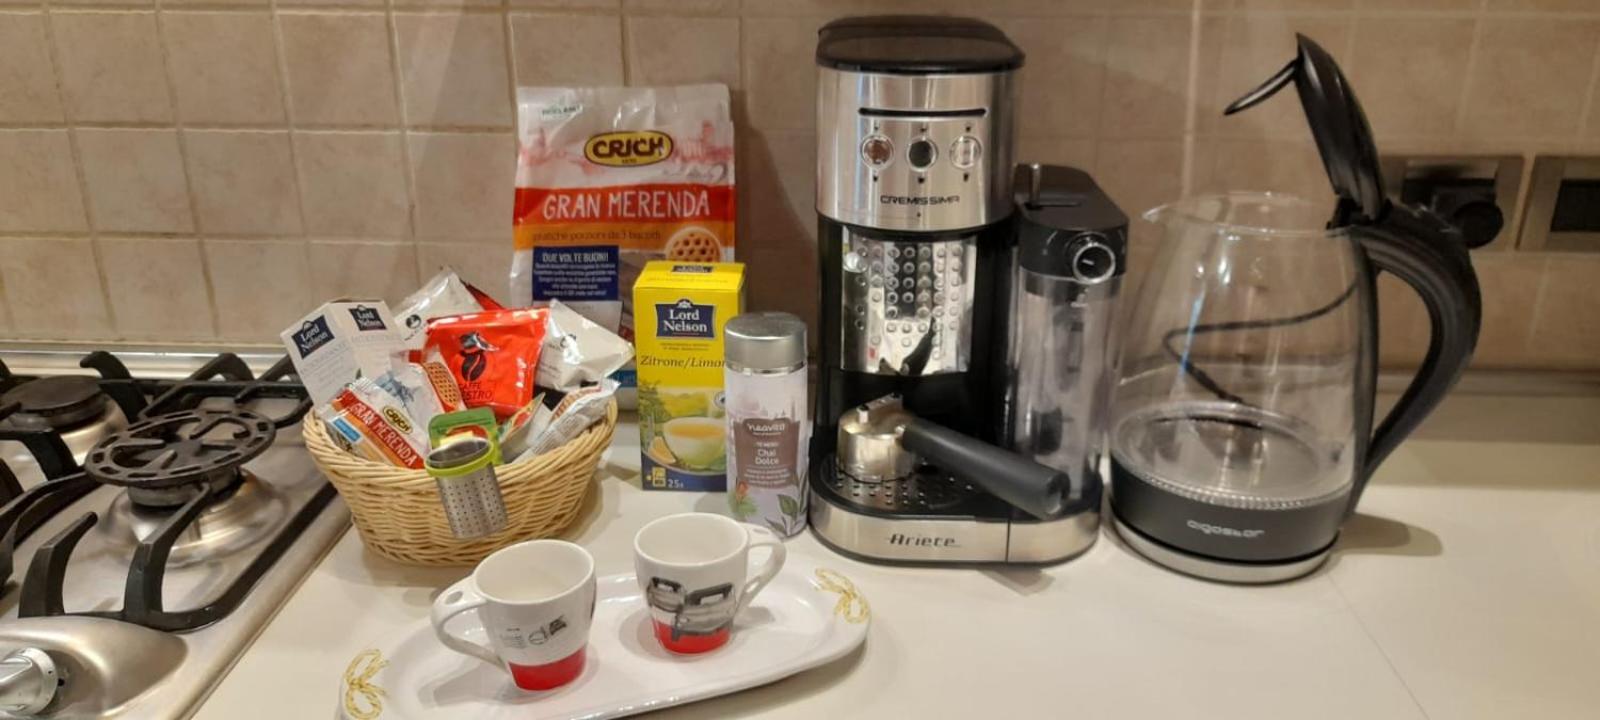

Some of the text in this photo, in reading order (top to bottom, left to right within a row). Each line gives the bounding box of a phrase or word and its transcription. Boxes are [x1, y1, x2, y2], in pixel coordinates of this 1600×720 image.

[593, 138, 664, 158] CRICH
[543, 190, 710, 219] GRAN MERENDA
[880, 195, 960, 205] CREMISSIMA
[669, 309, 700, 321] Lord
[301, 323, 320, 342] Lord
[663, 320, 708, 332] Nelson
[301, 331, 328, 352] Nelson
[385, 408, 411, 433] CRICH
[374, 420, 418, 466] MERENDA
[755, 457, 779, 466] Dolce
[889, 533, 955, 547] Ariete
